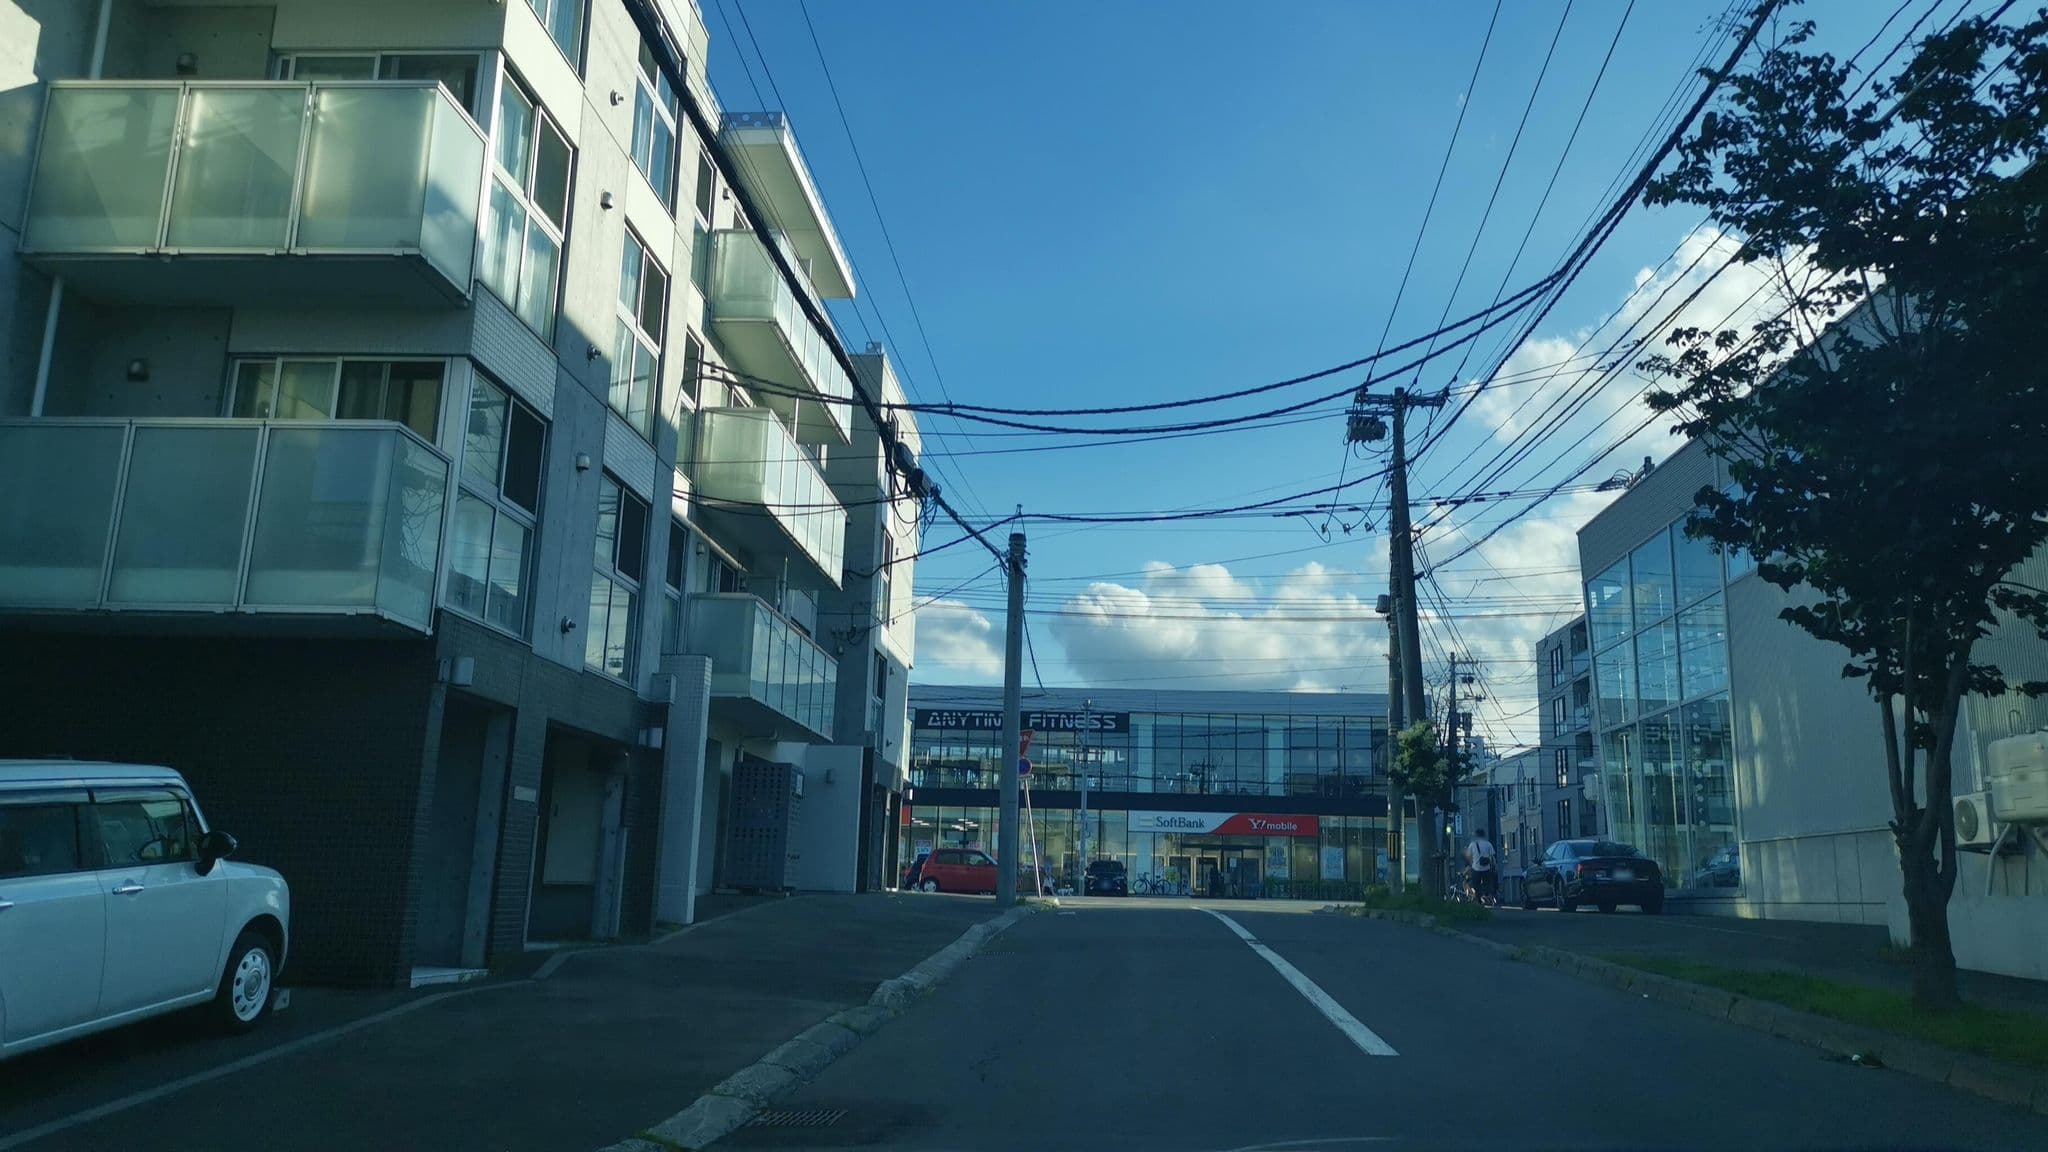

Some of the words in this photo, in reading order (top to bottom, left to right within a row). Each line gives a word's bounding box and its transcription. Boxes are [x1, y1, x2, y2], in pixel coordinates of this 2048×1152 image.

[928, 712, 1003, 728] ANYTIM
[1028, 713, 1117, 729] FITNESS
[1156, 816, 1205, 829] SoftBank
